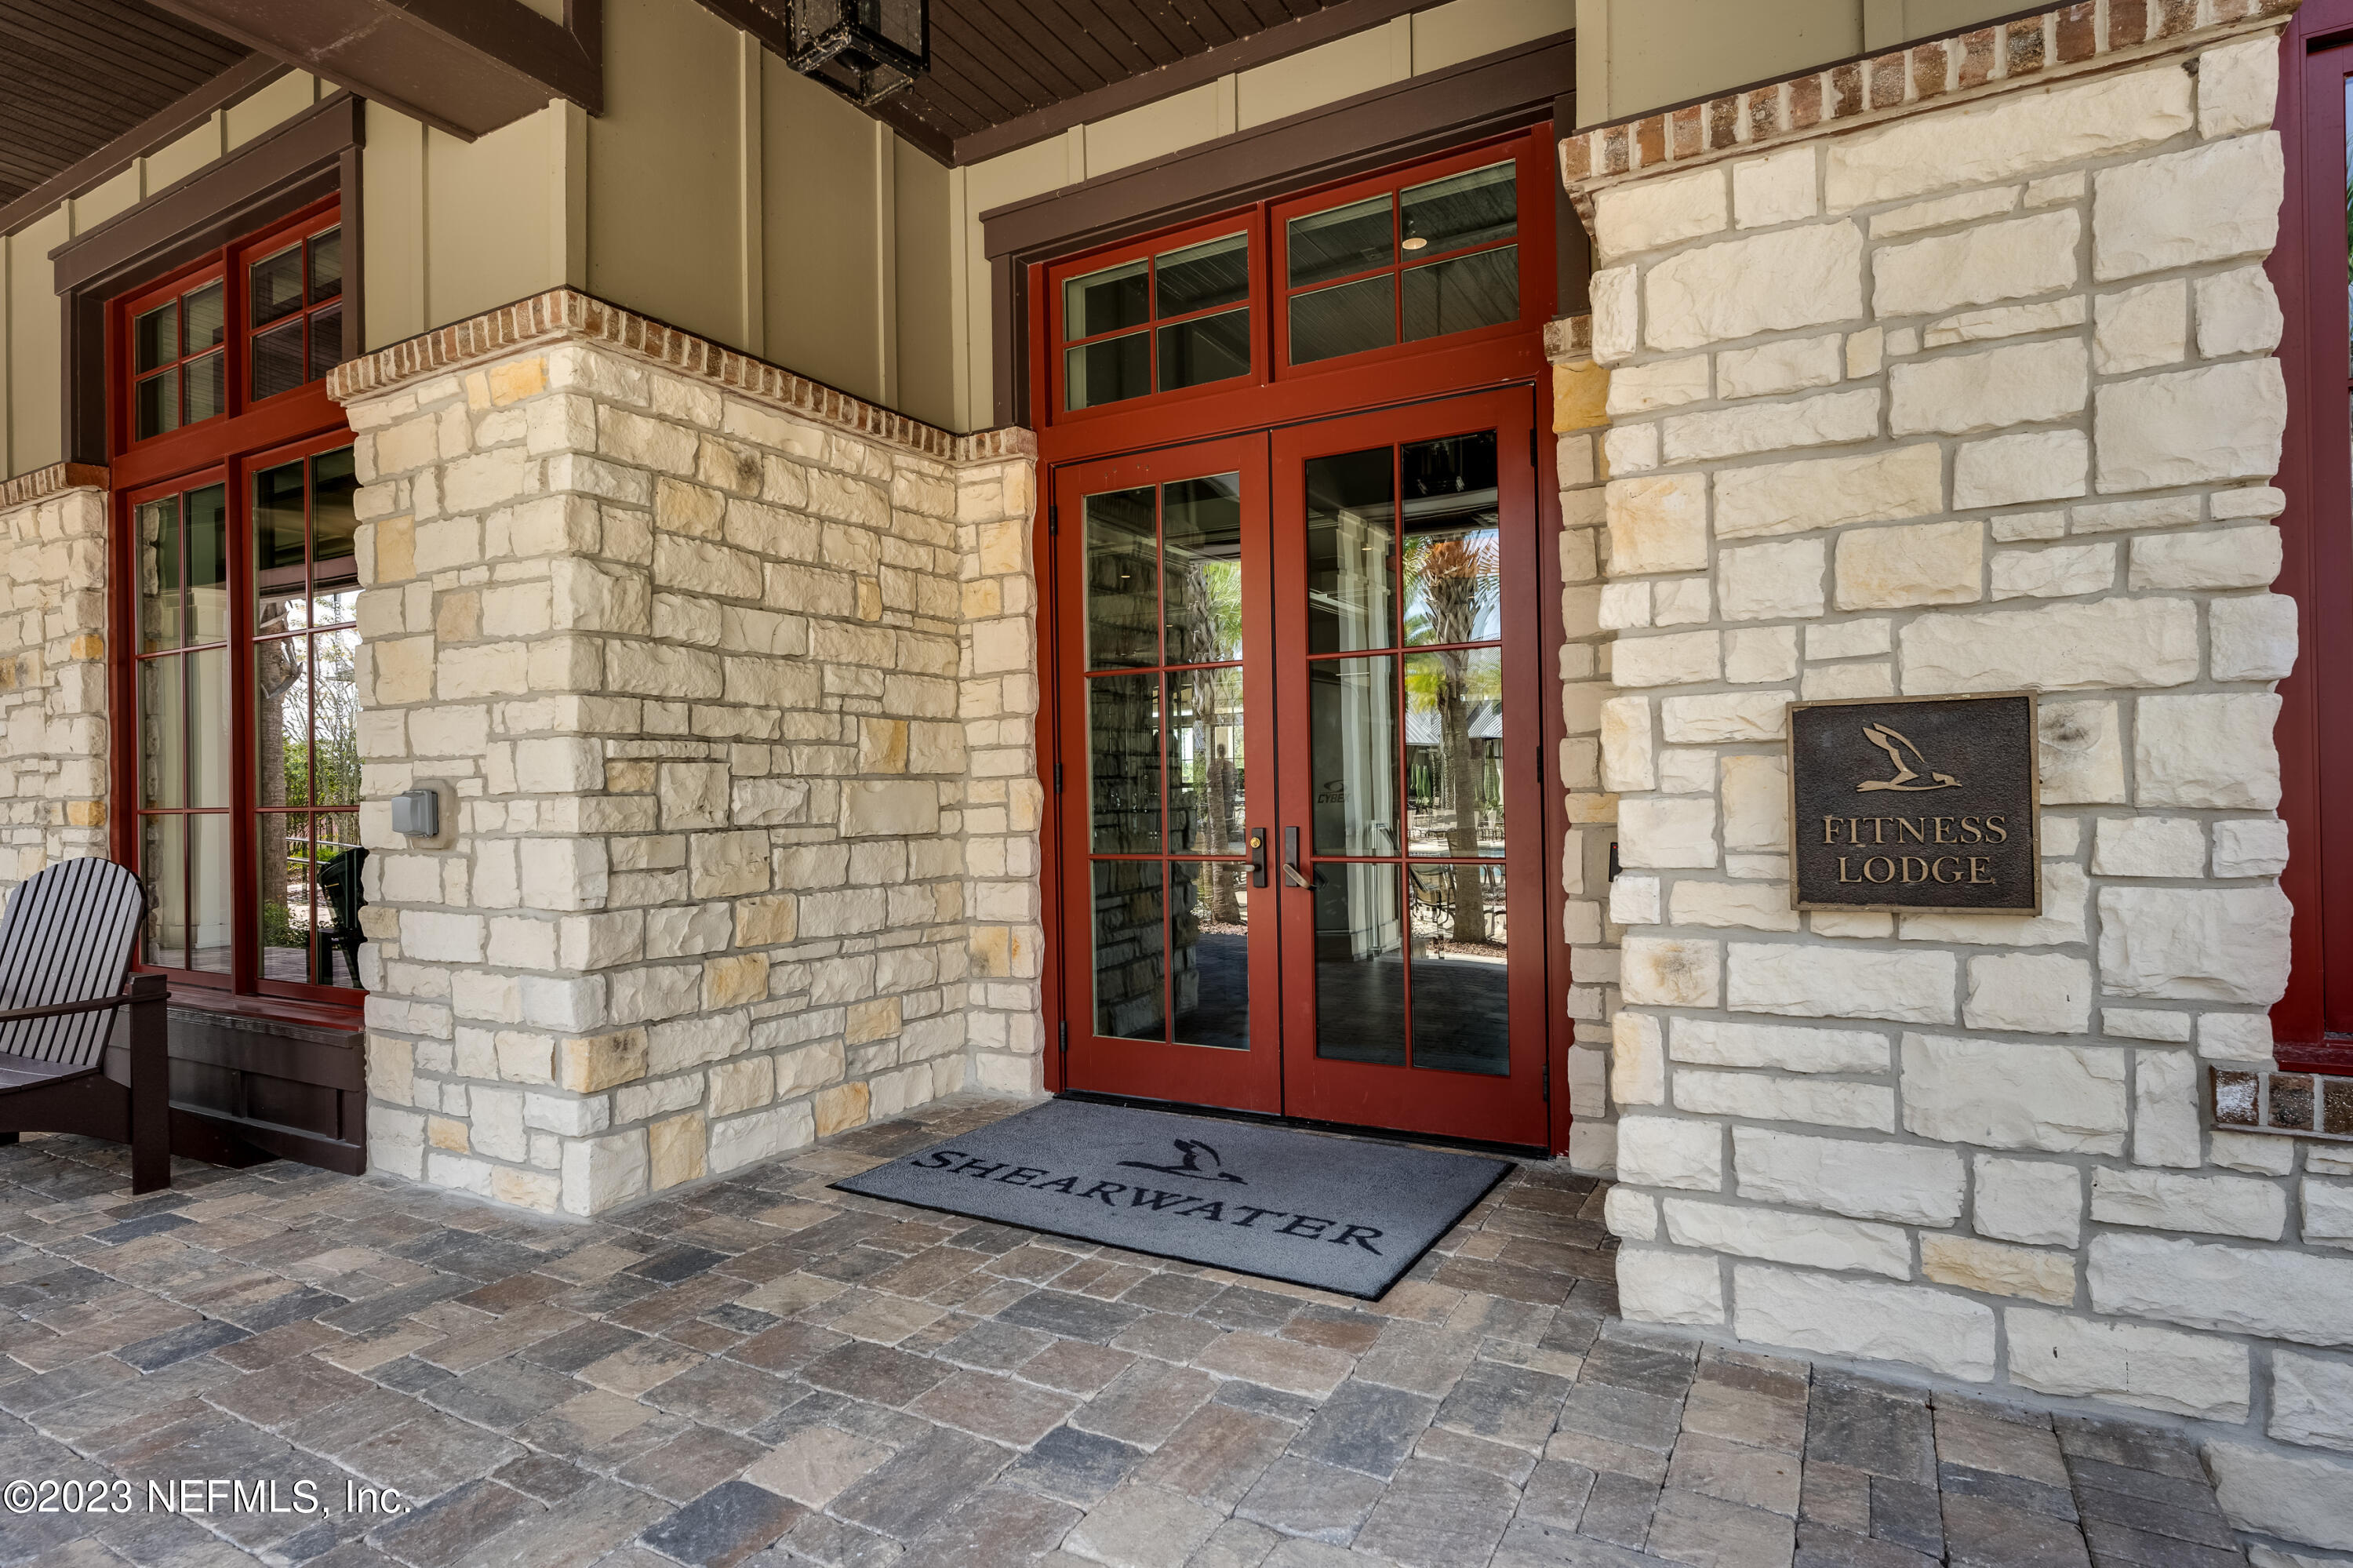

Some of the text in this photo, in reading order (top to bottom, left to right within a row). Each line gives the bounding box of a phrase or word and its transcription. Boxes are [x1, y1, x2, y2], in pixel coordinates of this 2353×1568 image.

[1822, 815, 2008, 845] FITNESS
[1838, 856, 1995, 885] LODGE
[911, 1150, 1384, 1256] SHEARWATER
